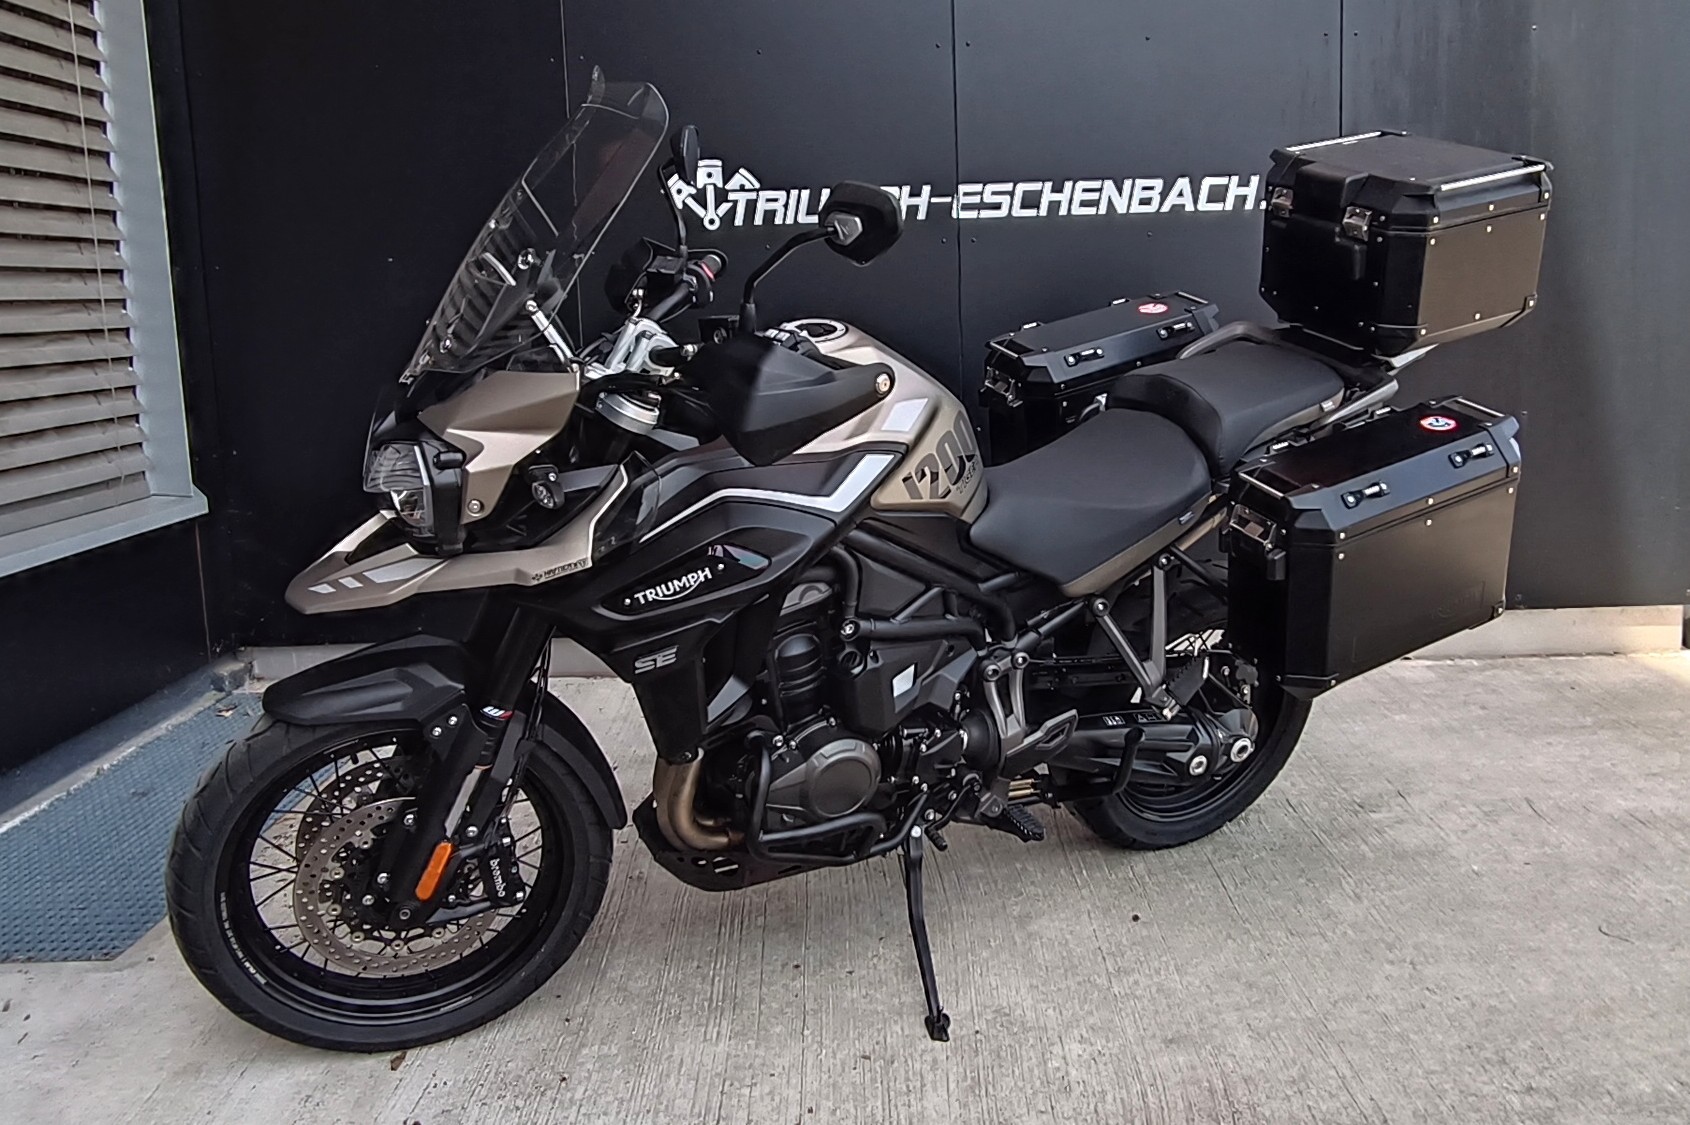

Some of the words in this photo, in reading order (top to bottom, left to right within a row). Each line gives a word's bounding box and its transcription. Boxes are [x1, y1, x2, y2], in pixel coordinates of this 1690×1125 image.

[727, 174, 1267, 227] TRIUH-ESCHENBACH.
[634, 567, 712, 604] TRIUMPH
[490, 858, 506, 897] brembo
